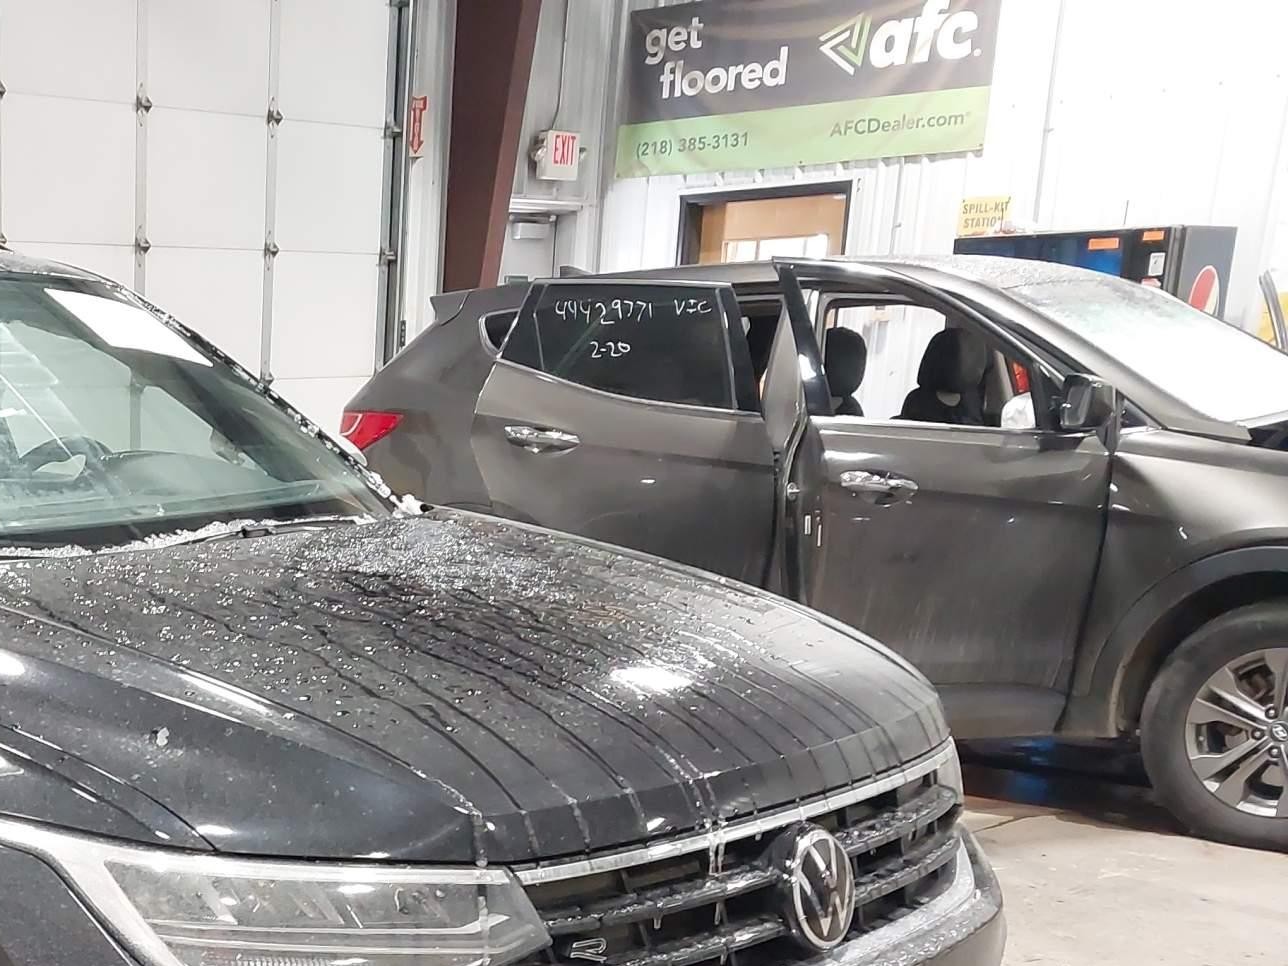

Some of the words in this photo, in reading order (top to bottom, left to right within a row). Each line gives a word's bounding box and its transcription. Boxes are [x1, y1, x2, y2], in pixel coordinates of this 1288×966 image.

[645, 17, 704, 65] get
[659, 46, 789, 99] floored
[553, 134, 577, 166] EXIT
[636, 139, 673, 159] (218)
[678, 131, 750, 153] 385-3131
[962, 201, 1009, 215] SPILL-KIT
[589, 340, 631, 358] 2-20
